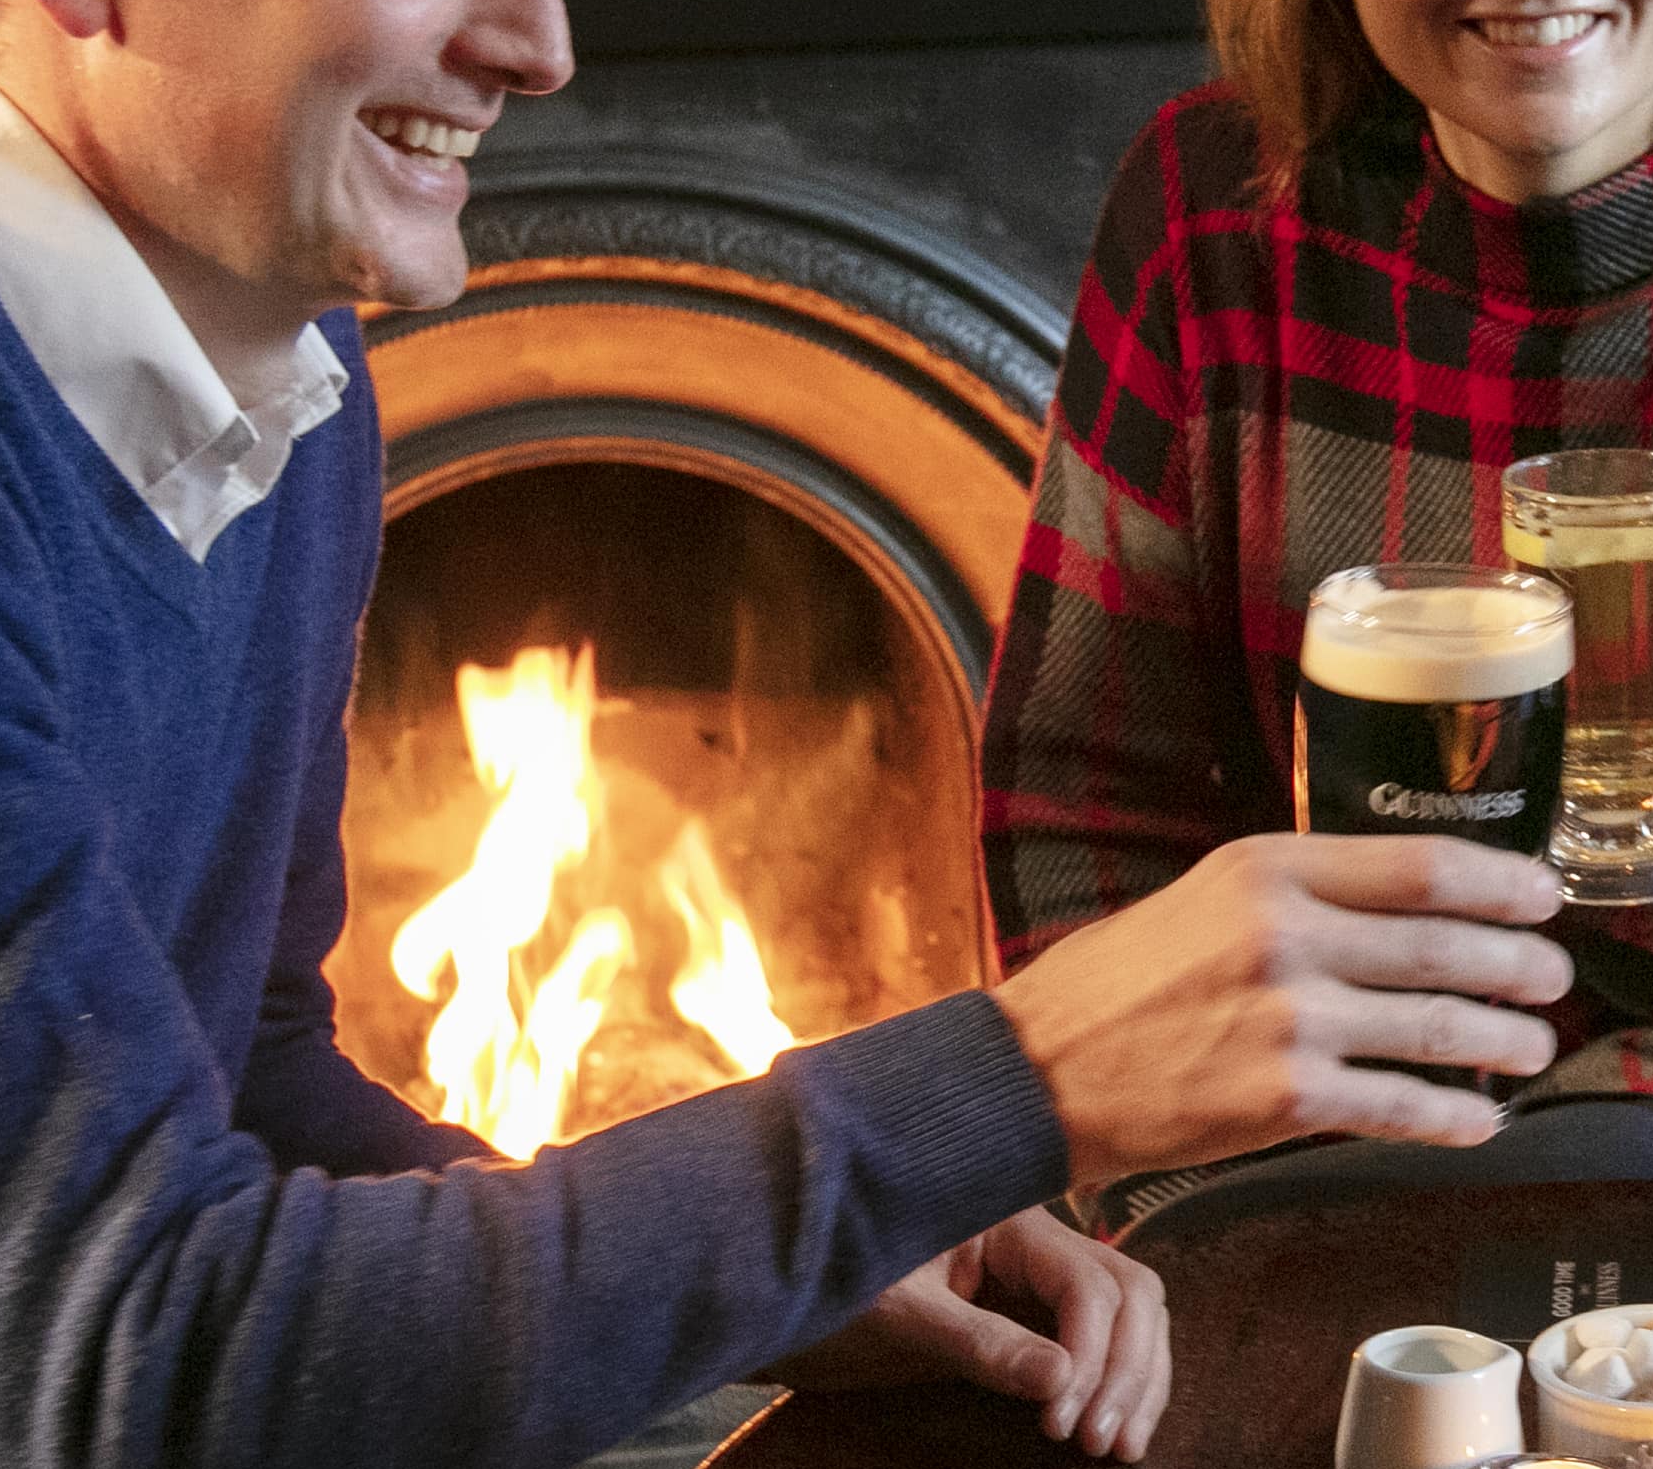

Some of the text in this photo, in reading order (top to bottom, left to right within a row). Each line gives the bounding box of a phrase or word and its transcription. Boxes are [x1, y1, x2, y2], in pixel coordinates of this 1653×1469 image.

[1551, 1261, 1577, 1318] GOOD TIME
[1596, 1261, 1622, 1309] UINNESS
